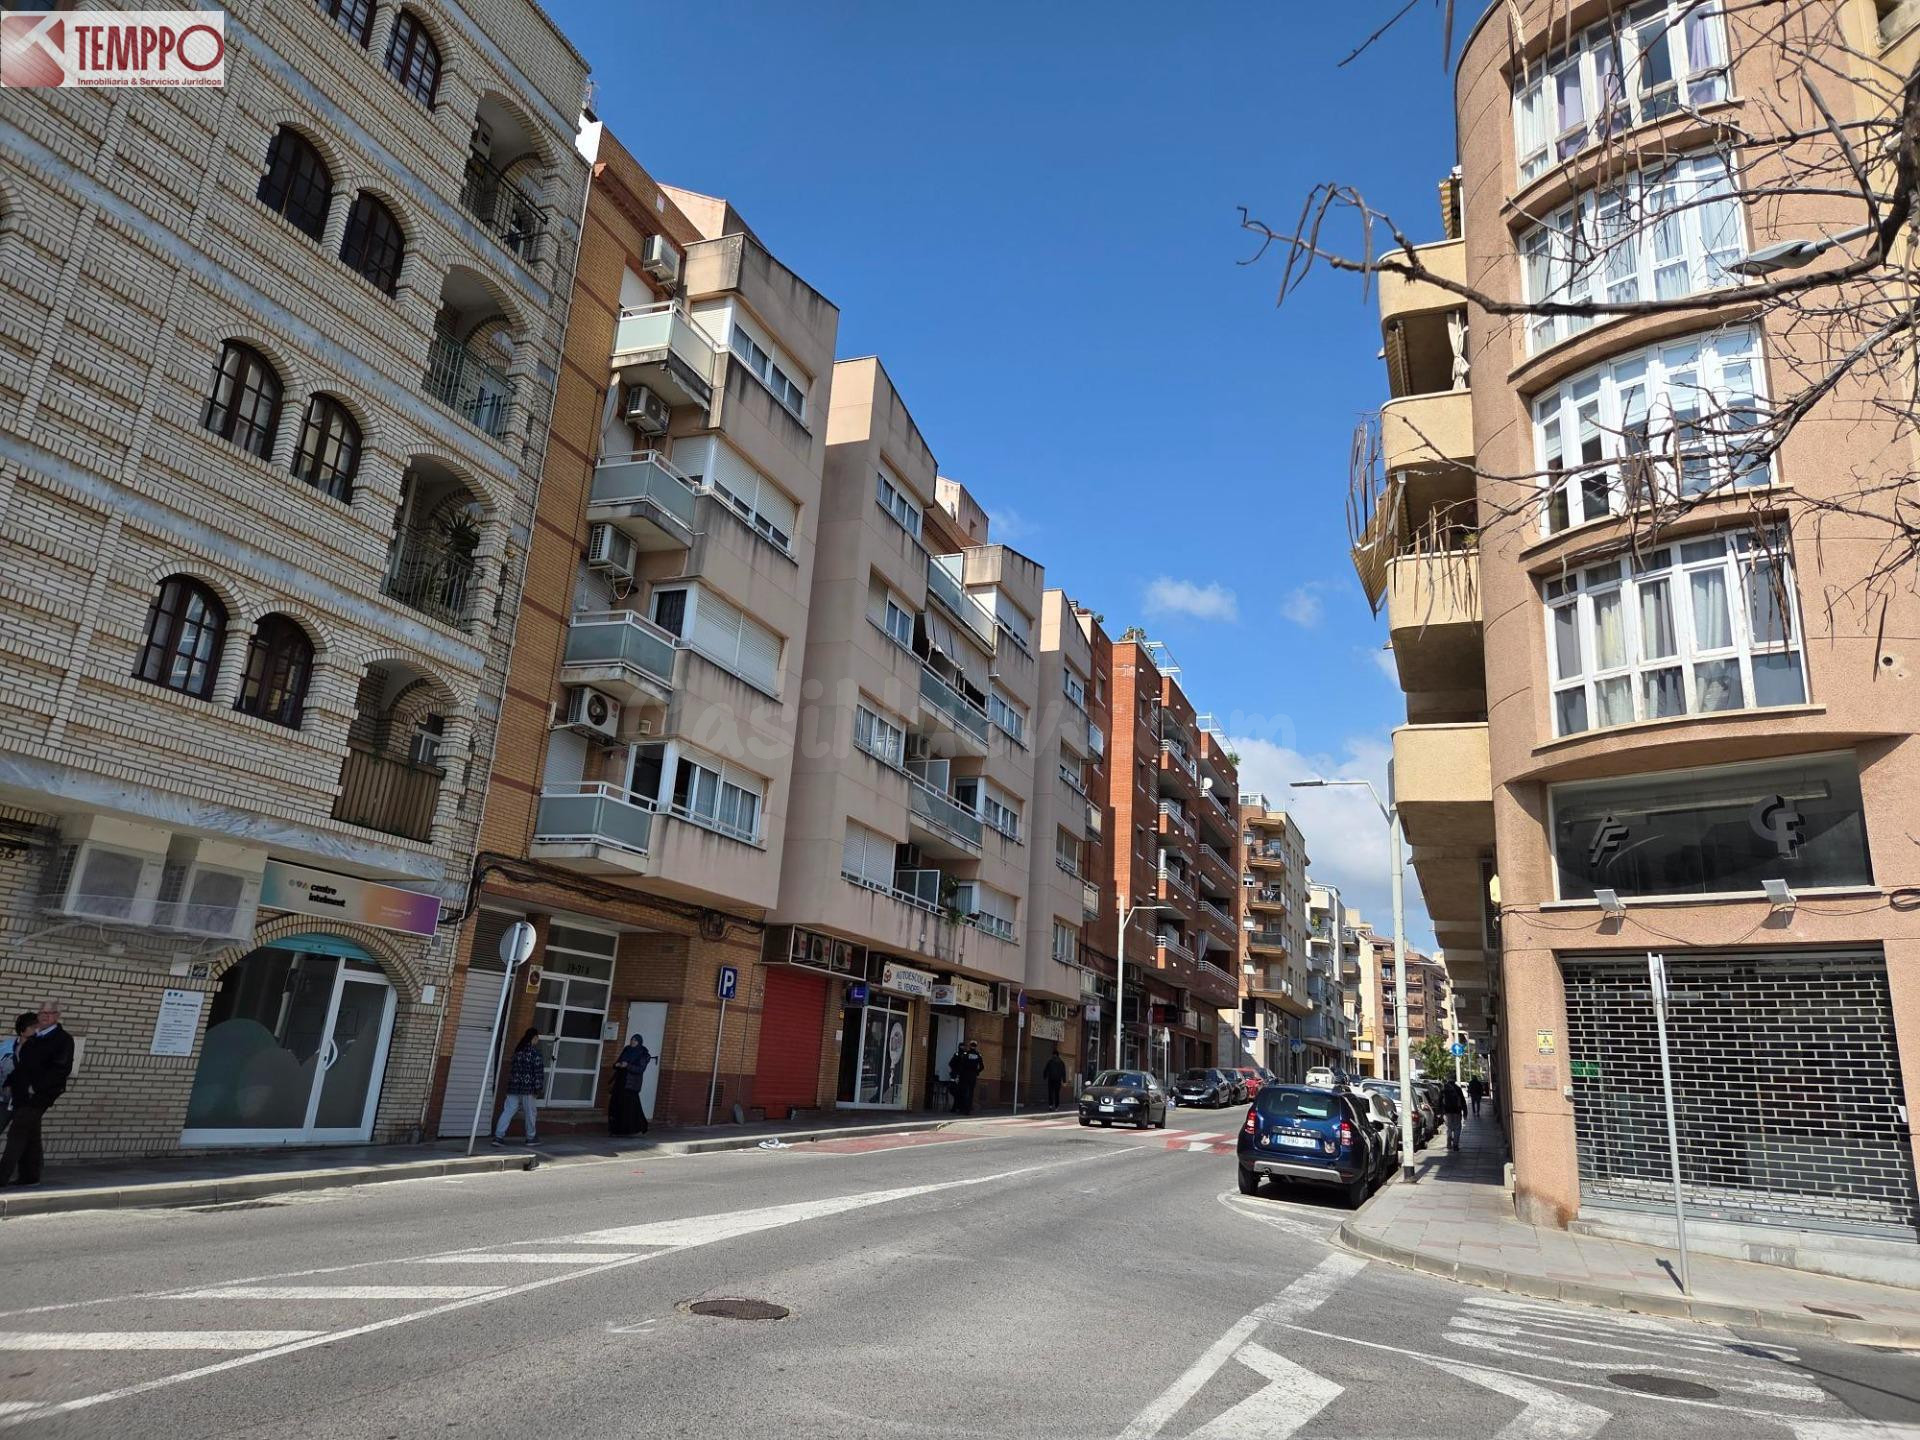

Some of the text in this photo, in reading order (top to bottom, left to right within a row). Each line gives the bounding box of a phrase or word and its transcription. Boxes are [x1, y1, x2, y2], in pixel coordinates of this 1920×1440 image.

[723, 970, 735, 995] P
[896, 970, 928, 987] AUTOESCOLA
[855, 986, 864, 998] L
